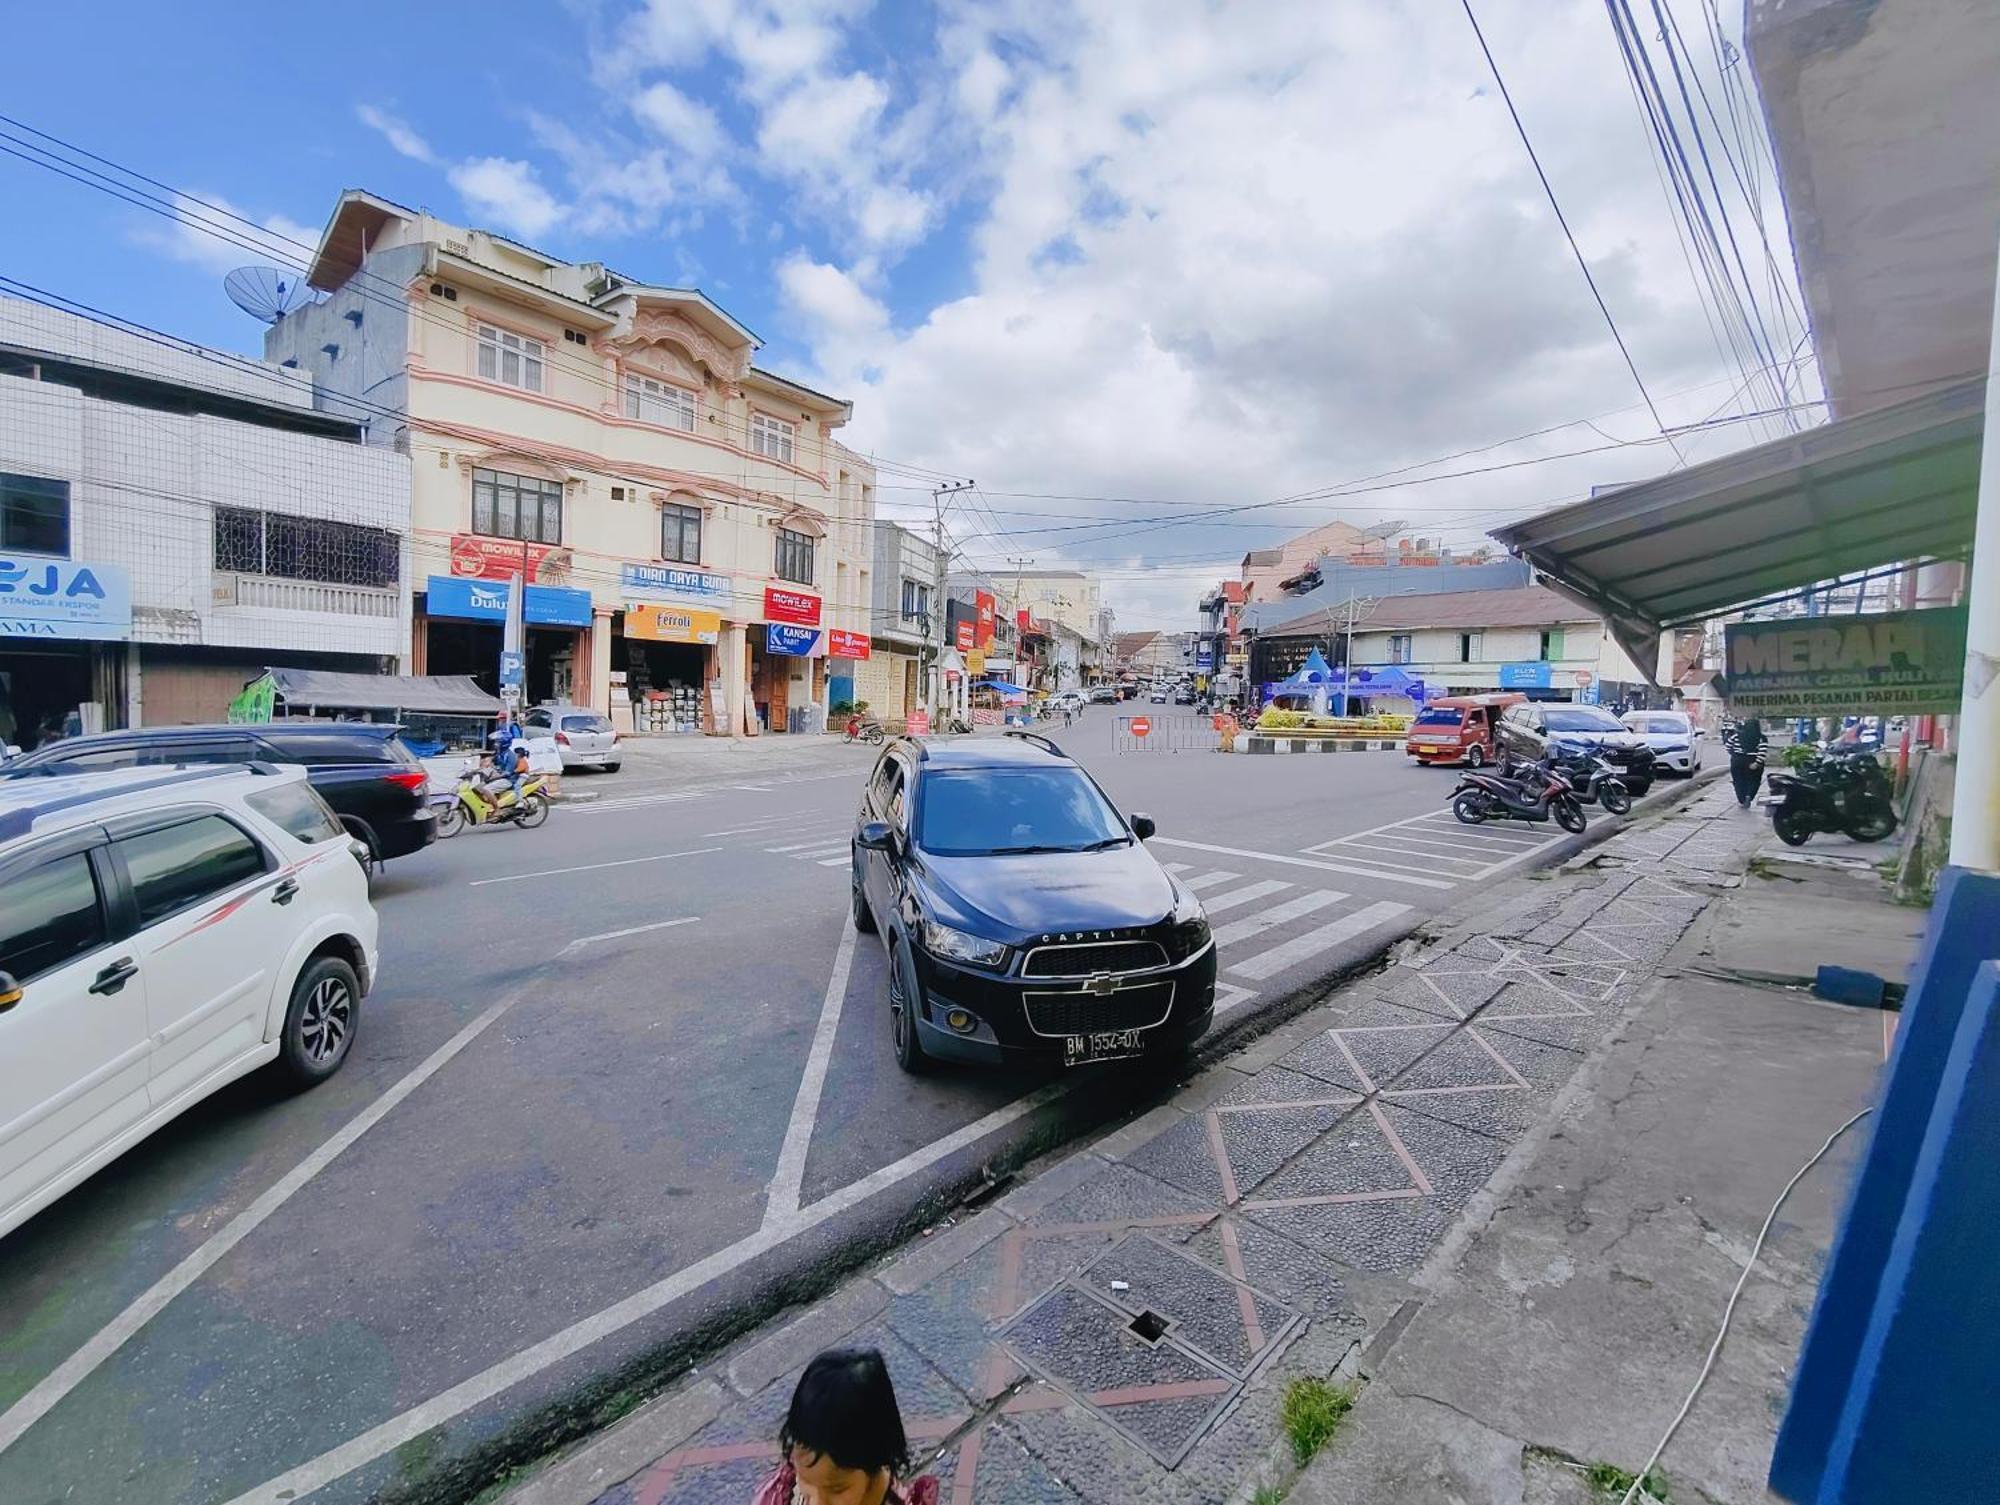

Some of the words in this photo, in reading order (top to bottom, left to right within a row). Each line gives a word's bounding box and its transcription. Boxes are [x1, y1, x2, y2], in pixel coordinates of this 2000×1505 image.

[639, 567, 666, 582] DIAN
[669, 570, 699, 586] DAYA
[702, 574, 730, 591] GUNA
[470, 595, 508, 610] Dulu
[656, 611, 691, 627] Ferroli
[783, 627, 812, 640] KANSAI
[503, 657, 519, 675] P
[1733, 692, 1801, 707] MENERIMA
[1803, 688, 1862, 705] PESANAN
[1866, 687, 1914, 702] PARTAI
[1041, 928, 1147, 943] CAPTIA
[1066, 1035, 1085, 1055] BM
